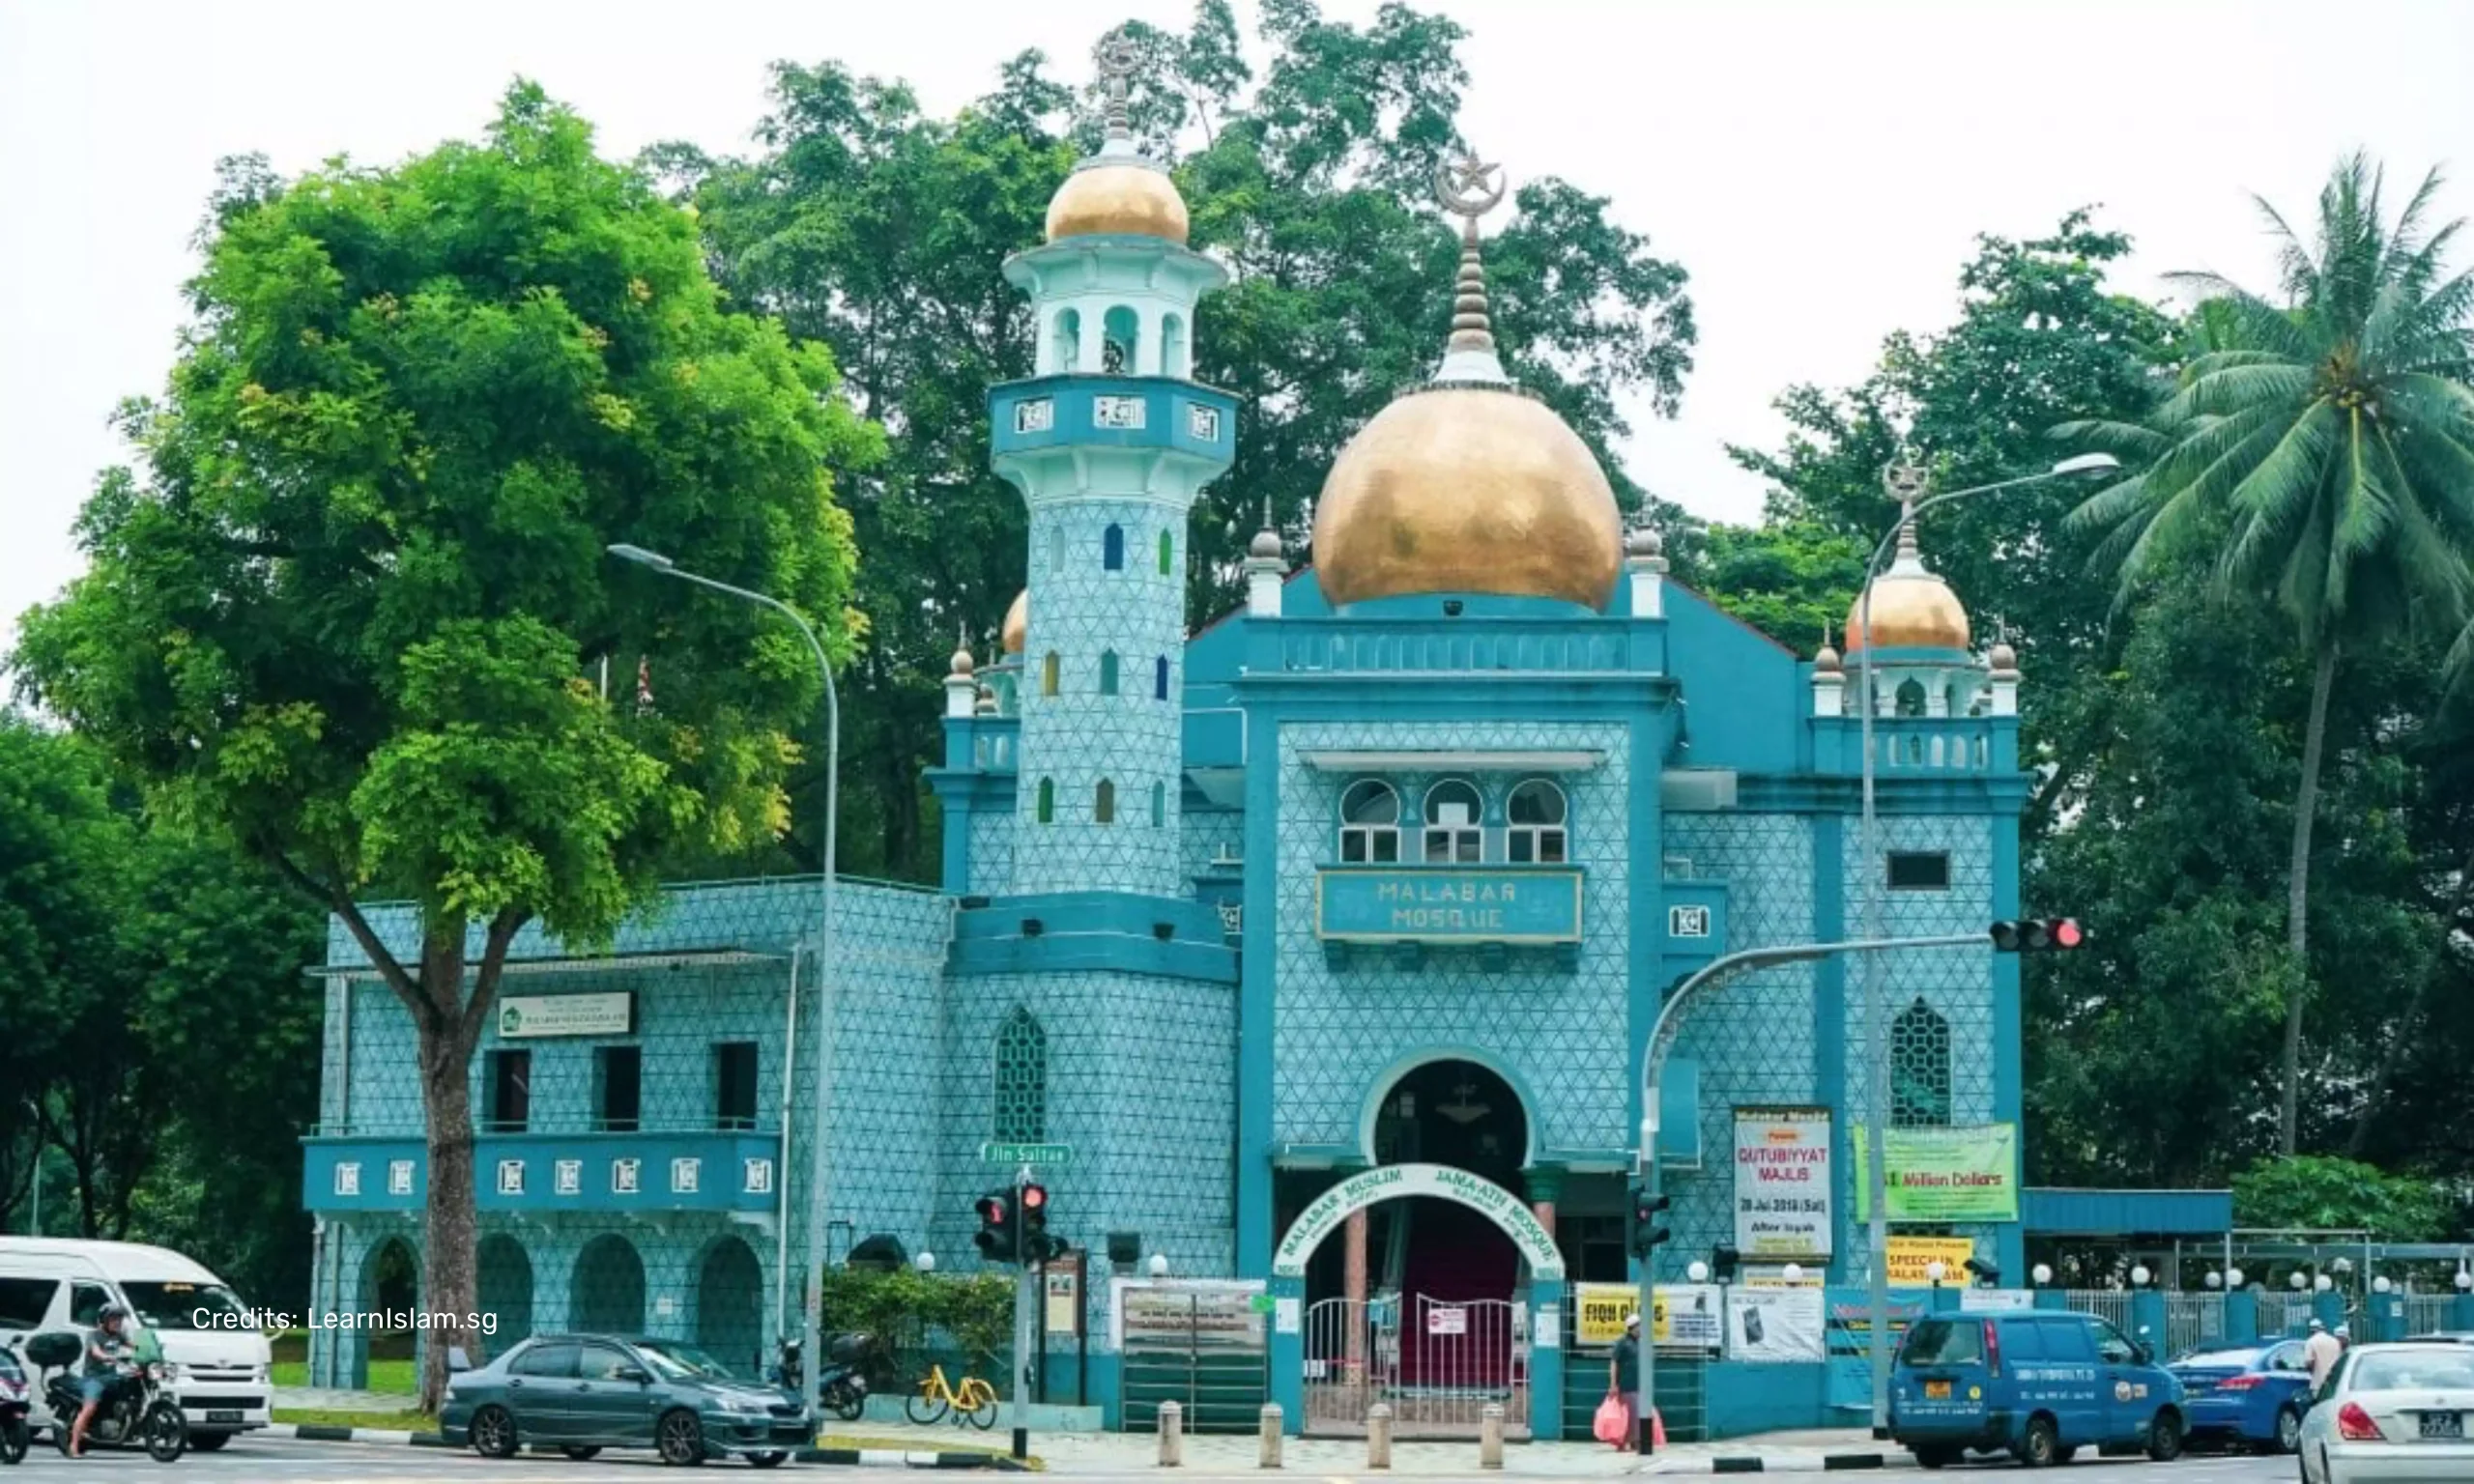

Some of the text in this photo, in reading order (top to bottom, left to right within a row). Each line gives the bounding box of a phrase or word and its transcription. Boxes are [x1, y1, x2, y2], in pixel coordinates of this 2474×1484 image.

[1377, 882, 1516, 901] MALABAR
[1392, 908, 1504, 928] MOSQUE
[1738, 1147, 1827, 1163] QUTUBIYYAT
[1759, 1167, 1810, 1182] MAJLIS
[1902, 1171, 1948, 1187] Million
[1952, 1171, 2002, 1187] Dollars
[1282, 1193, 1339, 1256] MALABAR
[1343, 1169, 1403, 1196] MUSLIM
[1509, 1205, 1556, 1261] MOSQUE
